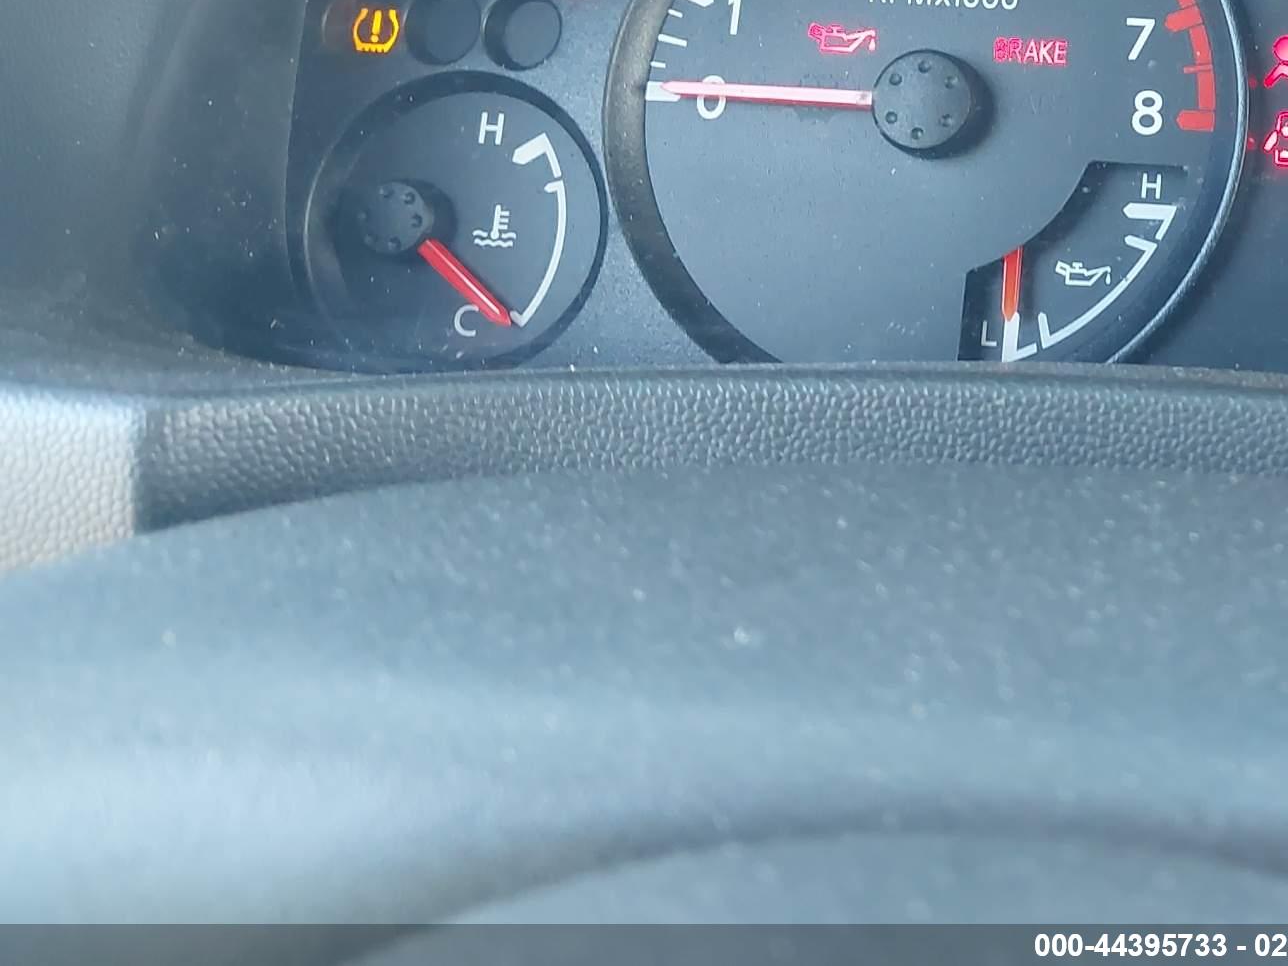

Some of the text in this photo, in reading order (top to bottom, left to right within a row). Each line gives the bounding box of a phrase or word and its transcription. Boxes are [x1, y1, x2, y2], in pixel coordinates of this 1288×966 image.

[993, 37, 1068, 65] BRAKE
[1125, 18, 1155, 61] 7
[696, 75, 727, 120] 0
[1131, 91, 1164, 134] 8
[478, 112, 505, 146] H
[1140, 173, 1163, 200] H
[453, 304, 479, 337] C
[980, 320, 997, 348] L
